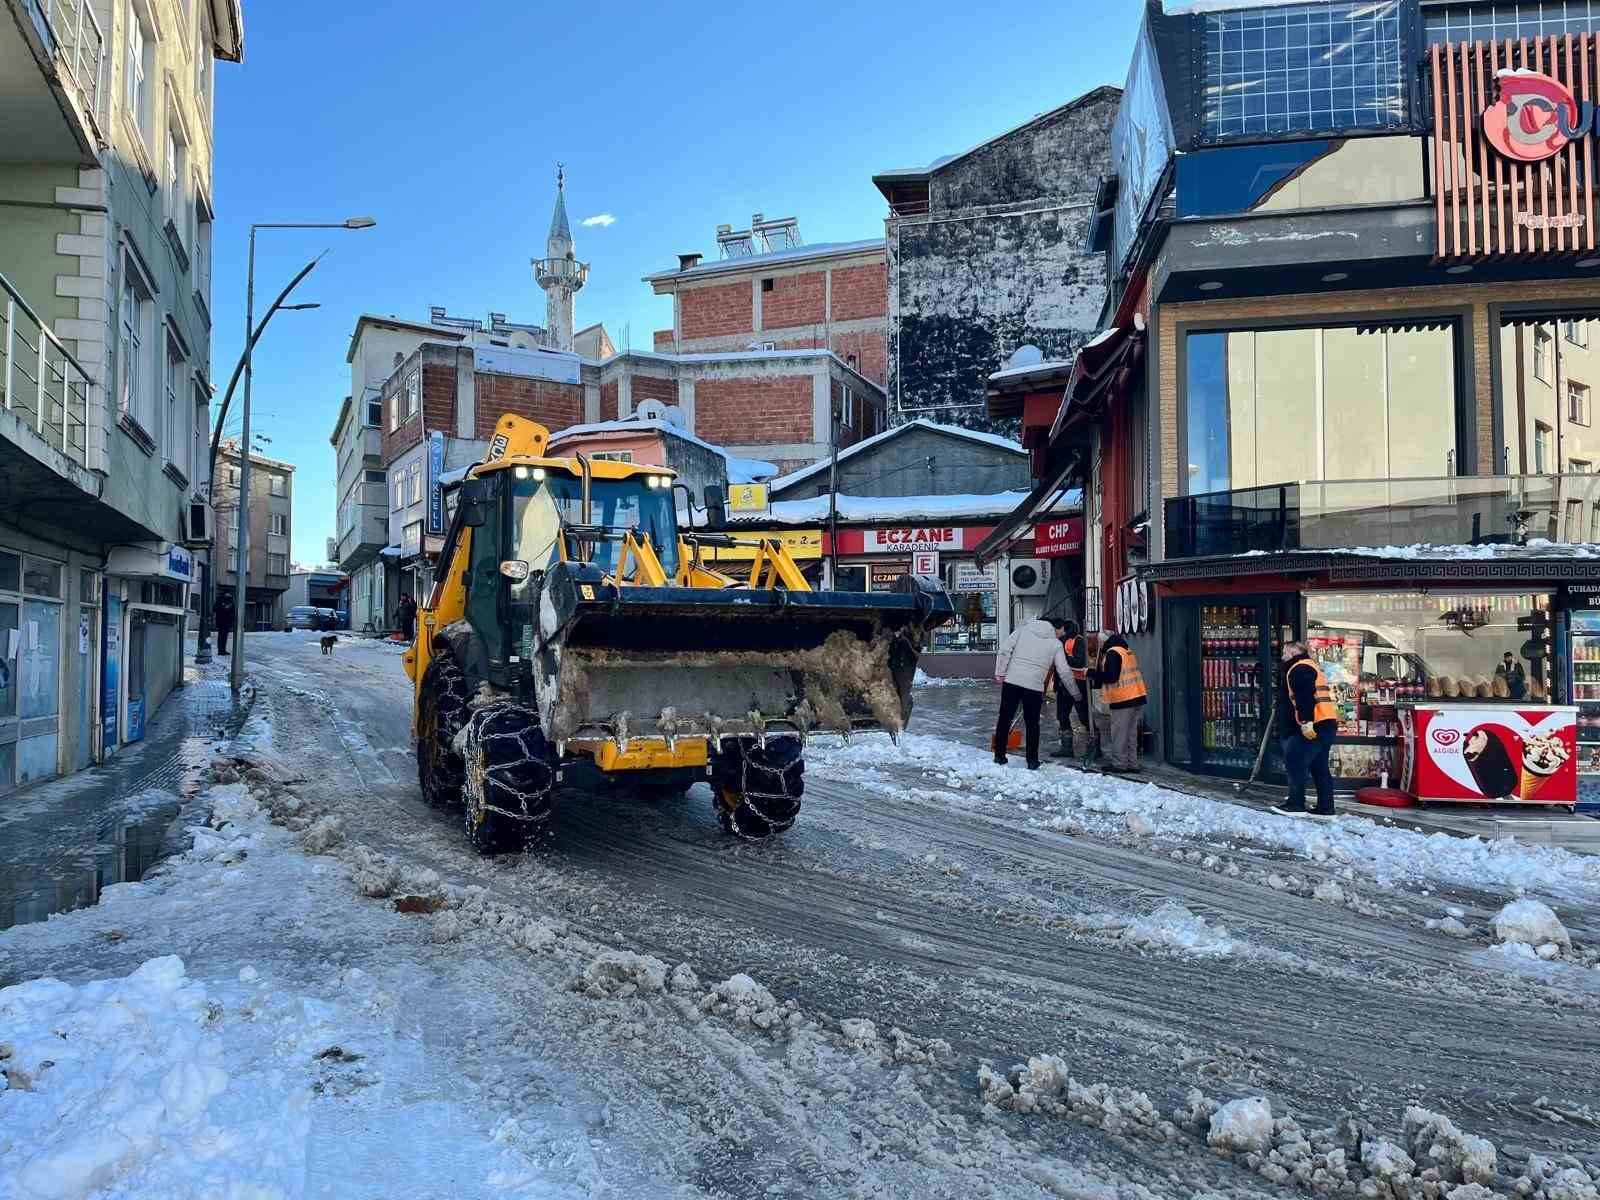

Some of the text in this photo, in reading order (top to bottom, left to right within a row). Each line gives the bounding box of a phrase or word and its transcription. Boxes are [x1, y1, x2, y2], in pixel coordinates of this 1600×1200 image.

[876, 527, 953, 544] ECZANE
[1049, 523, 1069, 539] CHP
[920, 558, 931, 572] E
